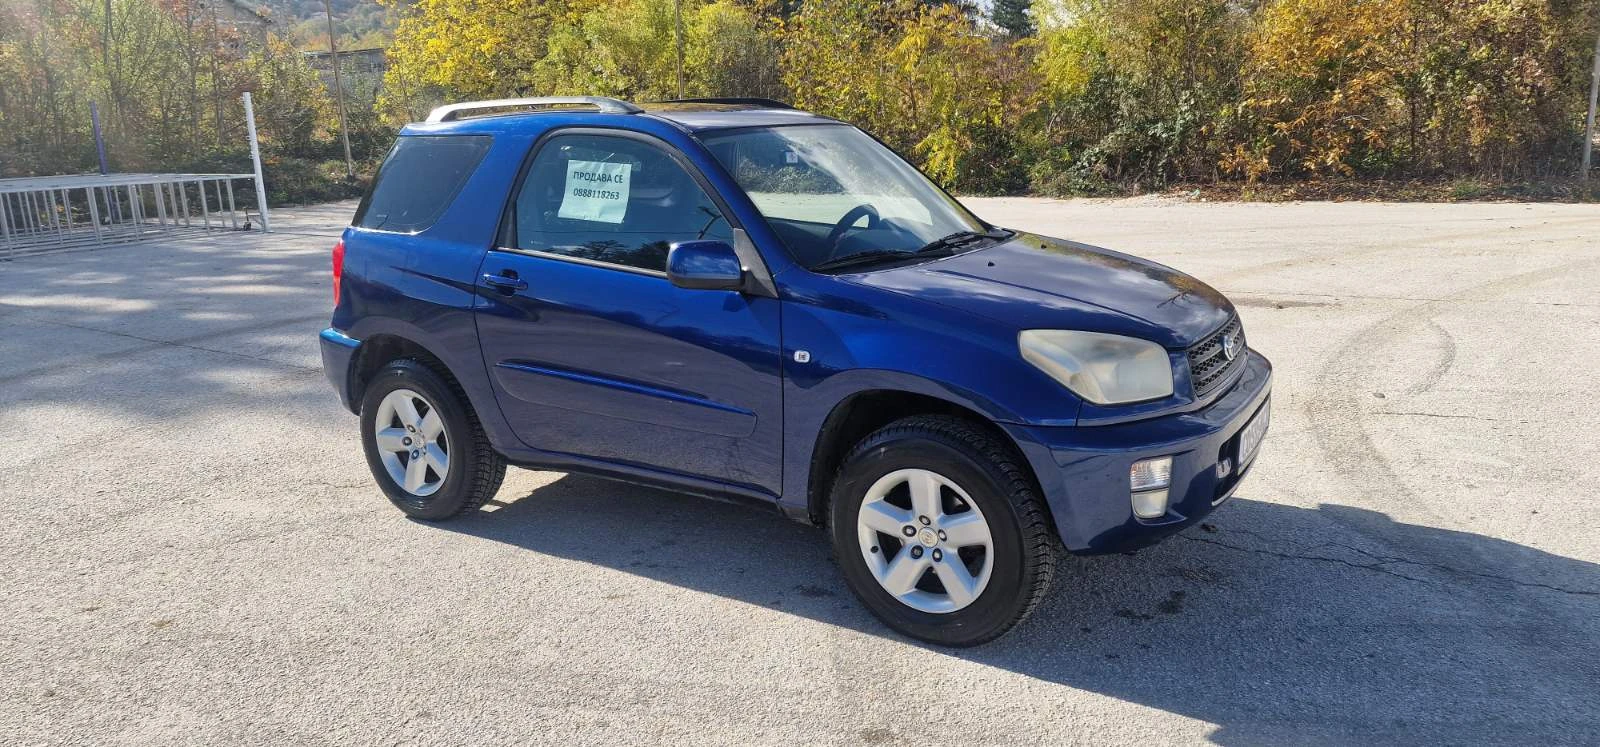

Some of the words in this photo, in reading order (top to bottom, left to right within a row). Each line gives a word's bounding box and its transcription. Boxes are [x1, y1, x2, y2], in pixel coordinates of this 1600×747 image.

[573, 171, 612, 183] ПРОДАВА
[614, 174, 623, 184] СЕ
[573, 188, 620, 200] 0888118263
